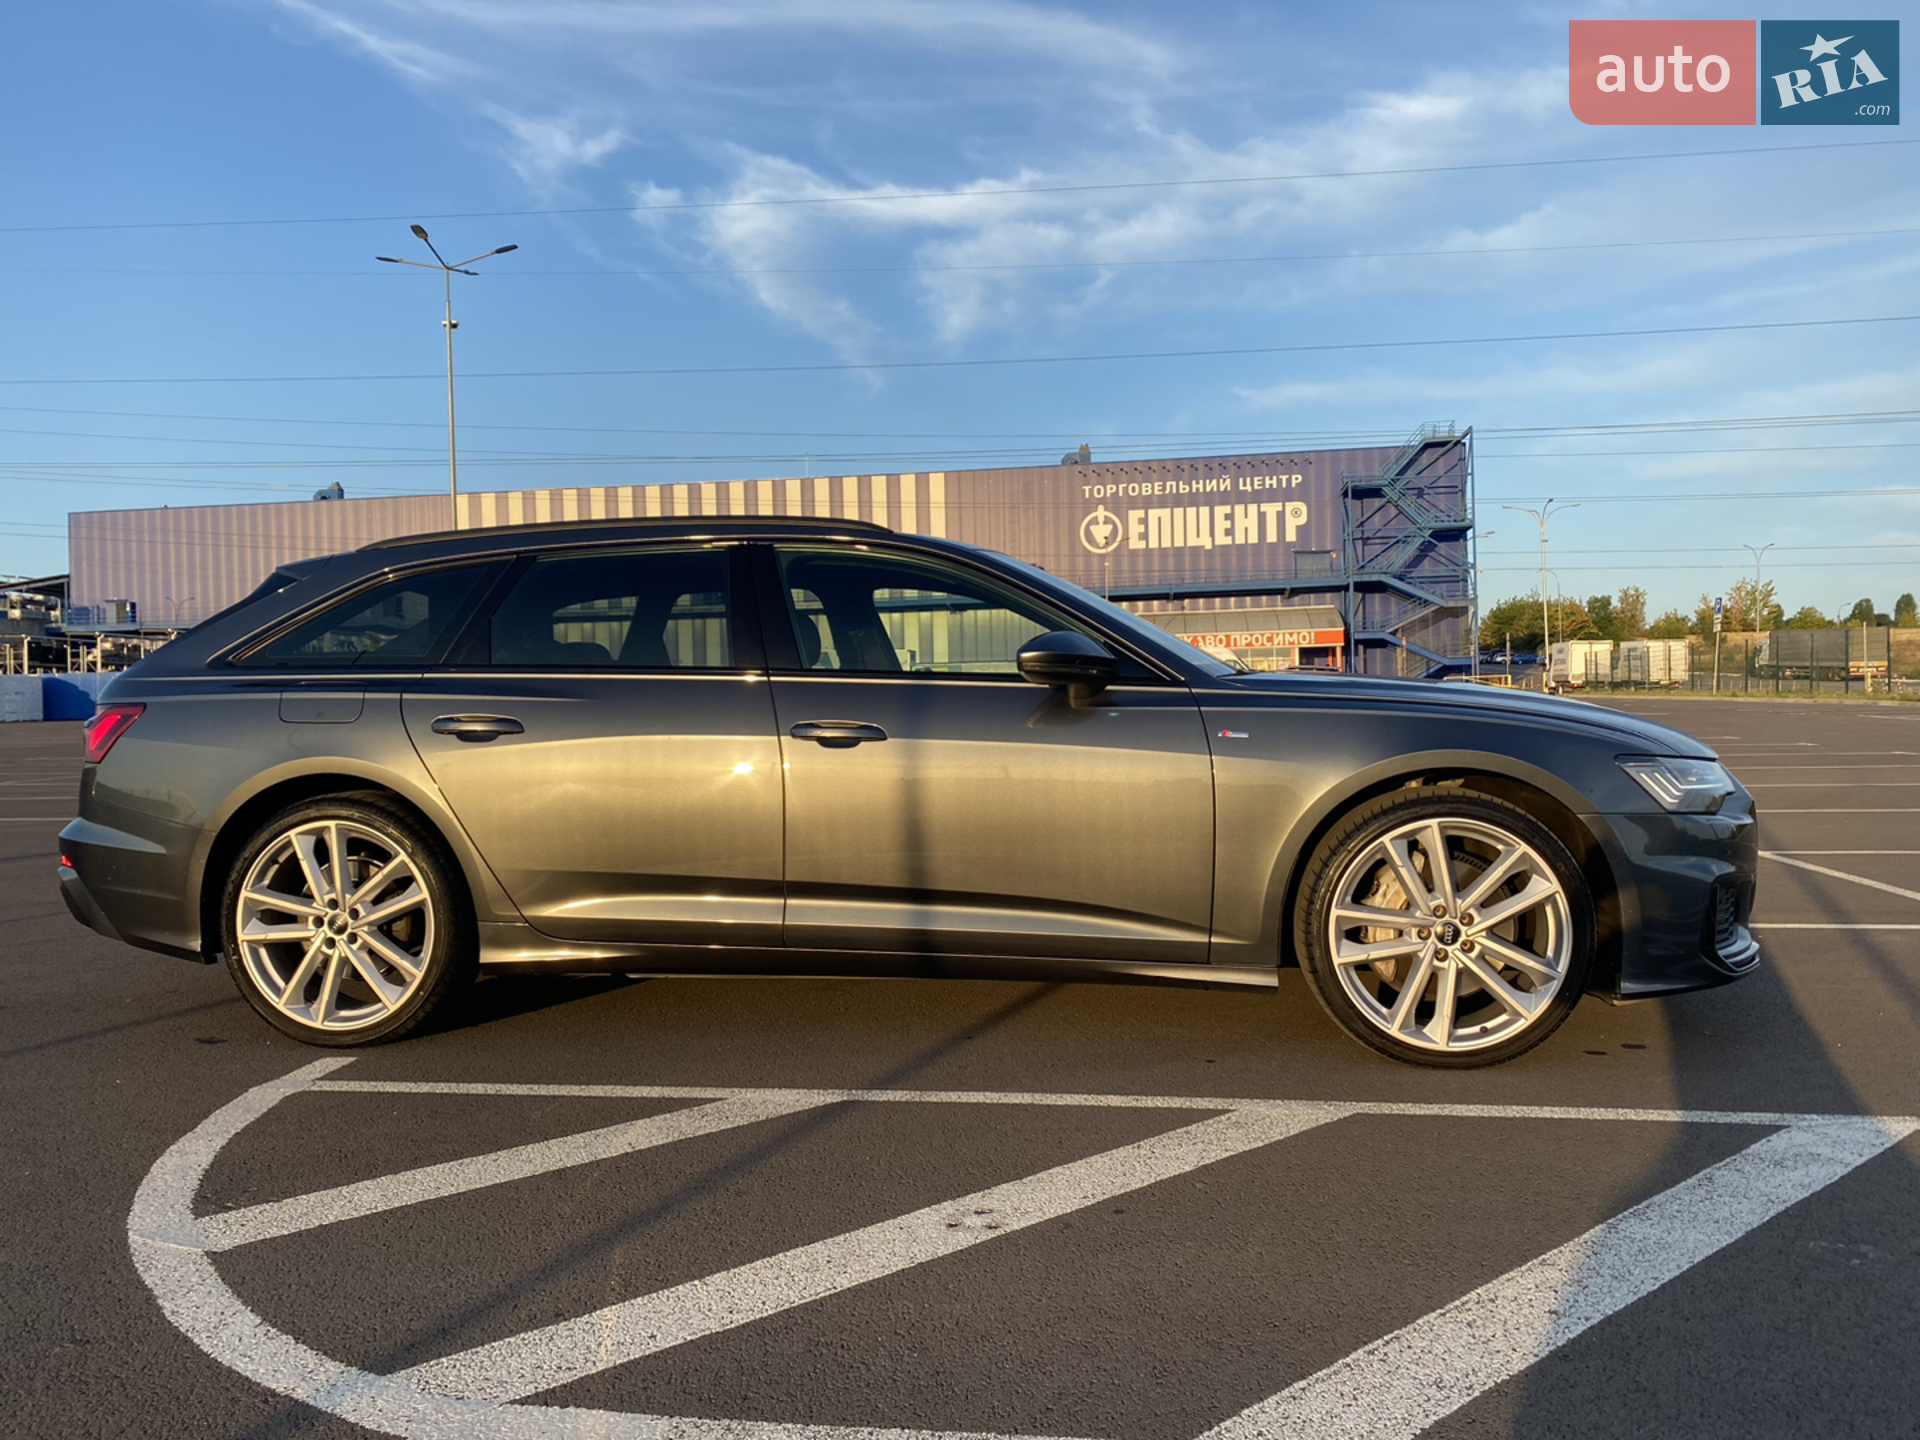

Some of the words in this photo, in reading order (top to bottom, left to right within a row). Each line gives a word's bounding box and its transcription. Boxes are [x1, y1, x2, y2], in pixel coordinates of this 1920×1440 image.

[1082, 475, 1231, 498] ТОРГОВЕЛЬНИЙ
[1238, 474, 1303, 493] ЦЕНТР
[1127, 501, 1308, 549] ЕПІЦЕНТР
[1230, 631, 1316, 647] ПРОСИМО!
